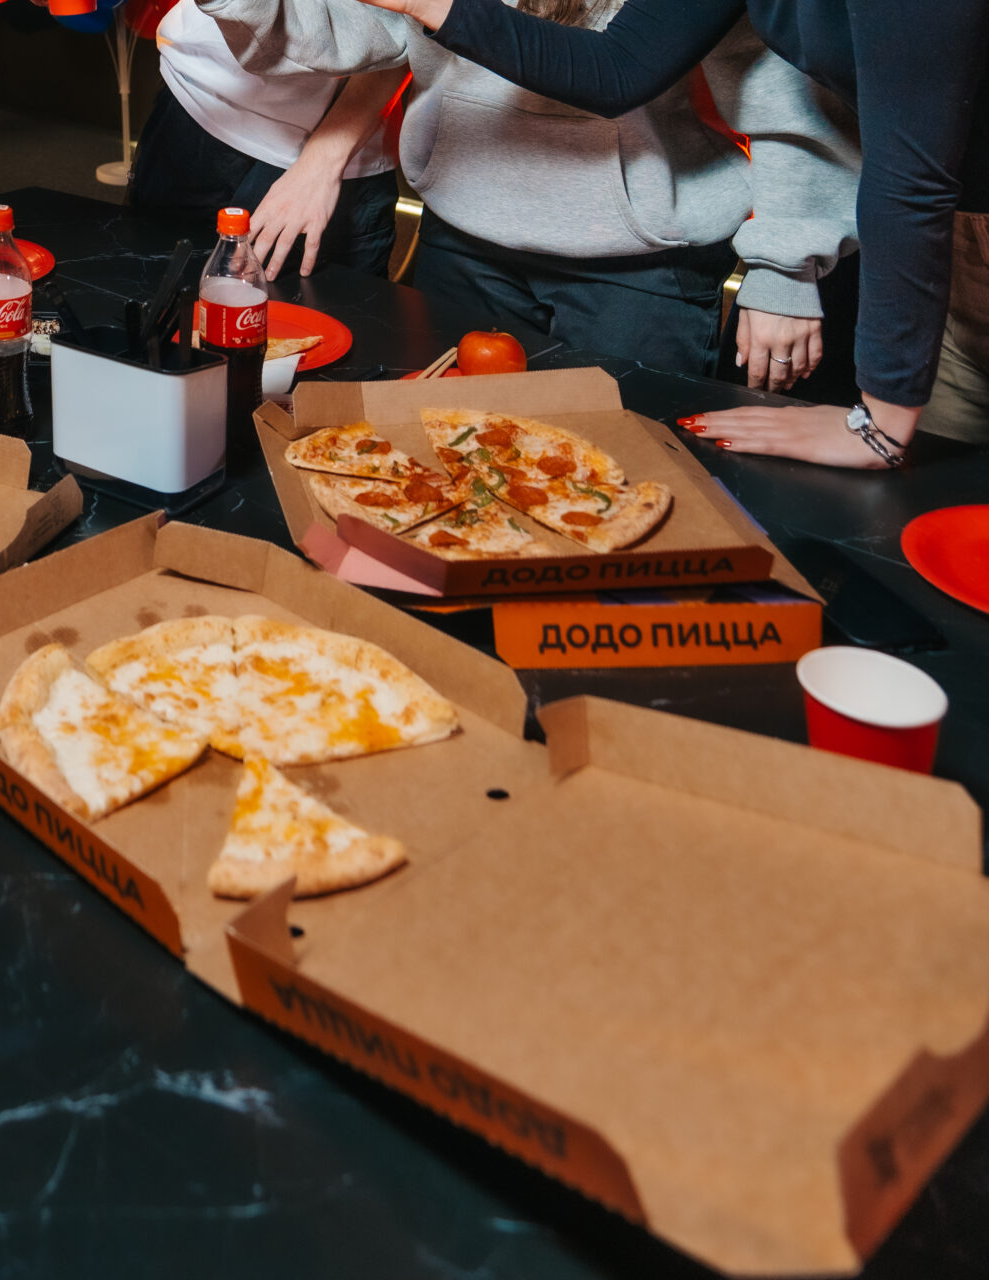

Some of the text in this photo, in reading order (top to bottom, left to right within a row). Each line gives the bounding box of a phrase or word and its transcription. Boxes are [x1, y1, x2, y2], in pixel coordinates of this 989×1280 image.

[481, 557, 734, 587] ДОДО ПИЦЦА
[539, 622, 782, 654] ДОДО ПИЦЦА
[35, 804, 146, 911] ПИЦЦА
